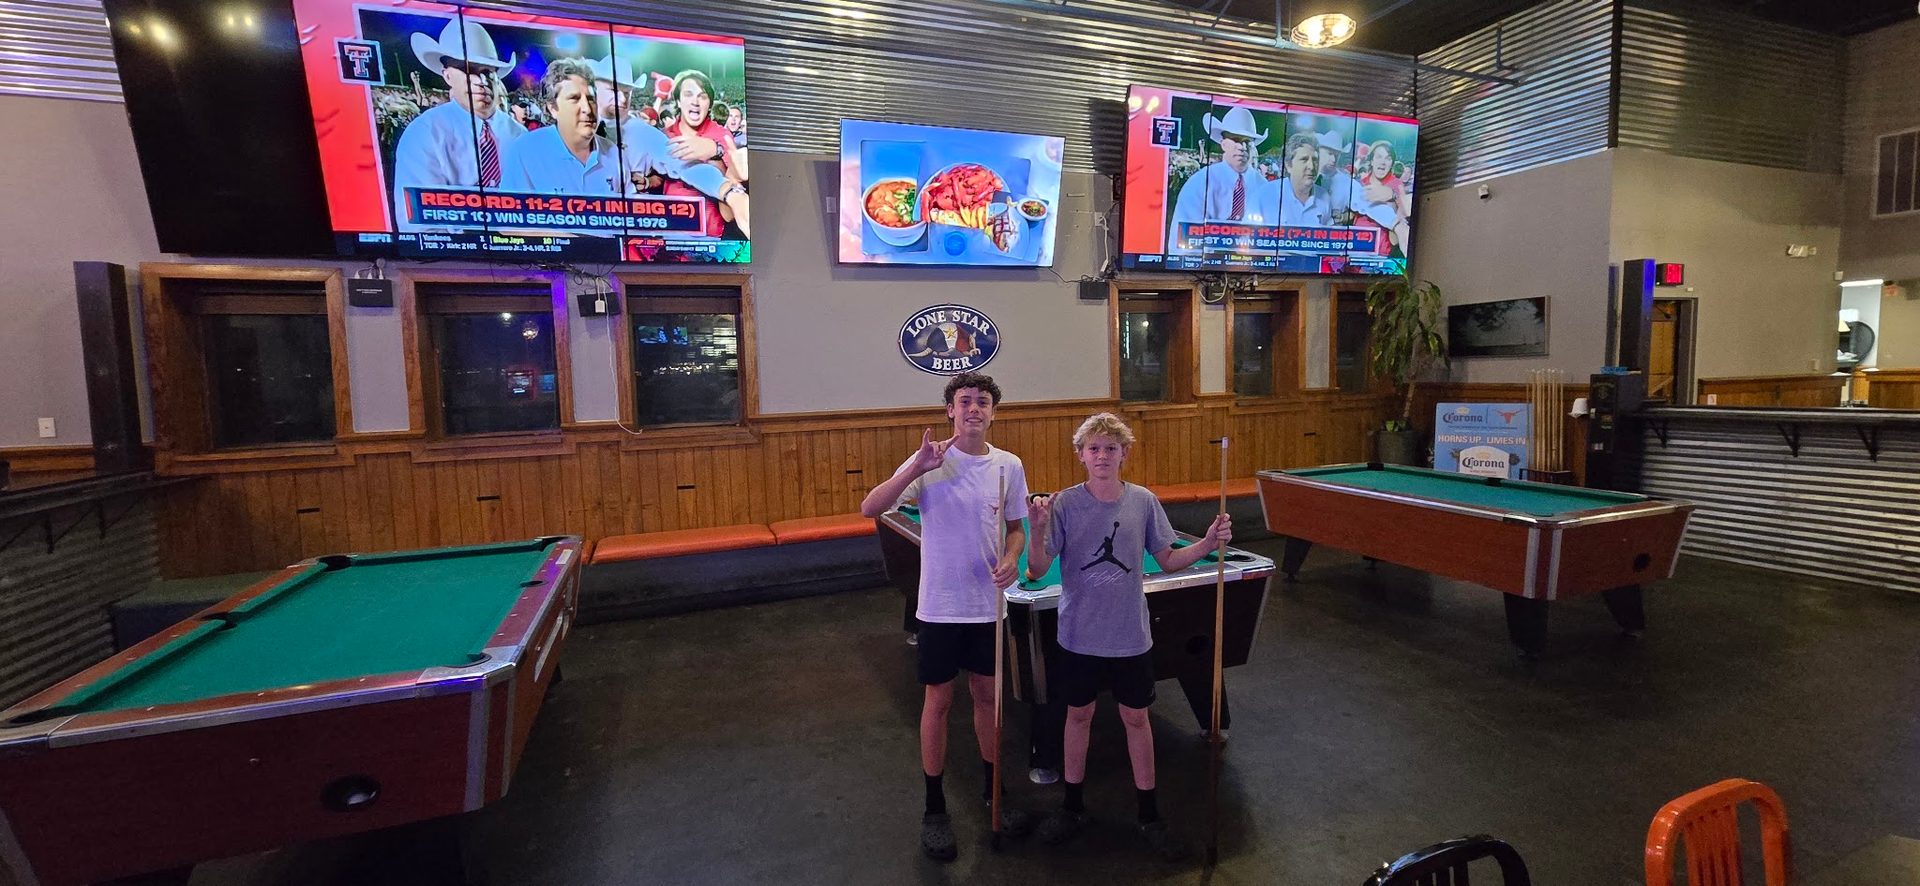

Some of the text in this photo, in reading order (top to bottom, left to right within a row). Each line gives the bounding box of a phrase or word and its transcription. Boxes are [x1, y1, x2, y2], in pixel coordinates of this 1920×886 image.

[421, 192, 696, 218] RECORD: 11-2 (7-1 IN BIG 12)
[422, 209, 467, 222] FIRST
[470, 210, 492, 222] 10
[494, 212, 524, 224] WIN
[526, 213, 587, 226] SEASON
[588, 215, 635, 228] SINCE
[1188, 225, 1254, 236] RECORD:
[1257, 228, 1285, 238] 11-2
[1221, 237, 1233, 246] 10
[1235, 238, 1255, 247] WIN
[1256, 239, 1299, 248] SEASON
[1300, 240, 1330, 249] SINCE
[1331, 241, 1354, 250] 1976
[906, 310, 990, 338] LONE STAR
[931, 356, 973, 371] BEER
[1442, 412, 1483, 424] Corona
[1438, 435, 1468, 443] HORNS
[1486, 437, 1514, 445] LIMES
[1461, 456, 1505, 469] Corona
